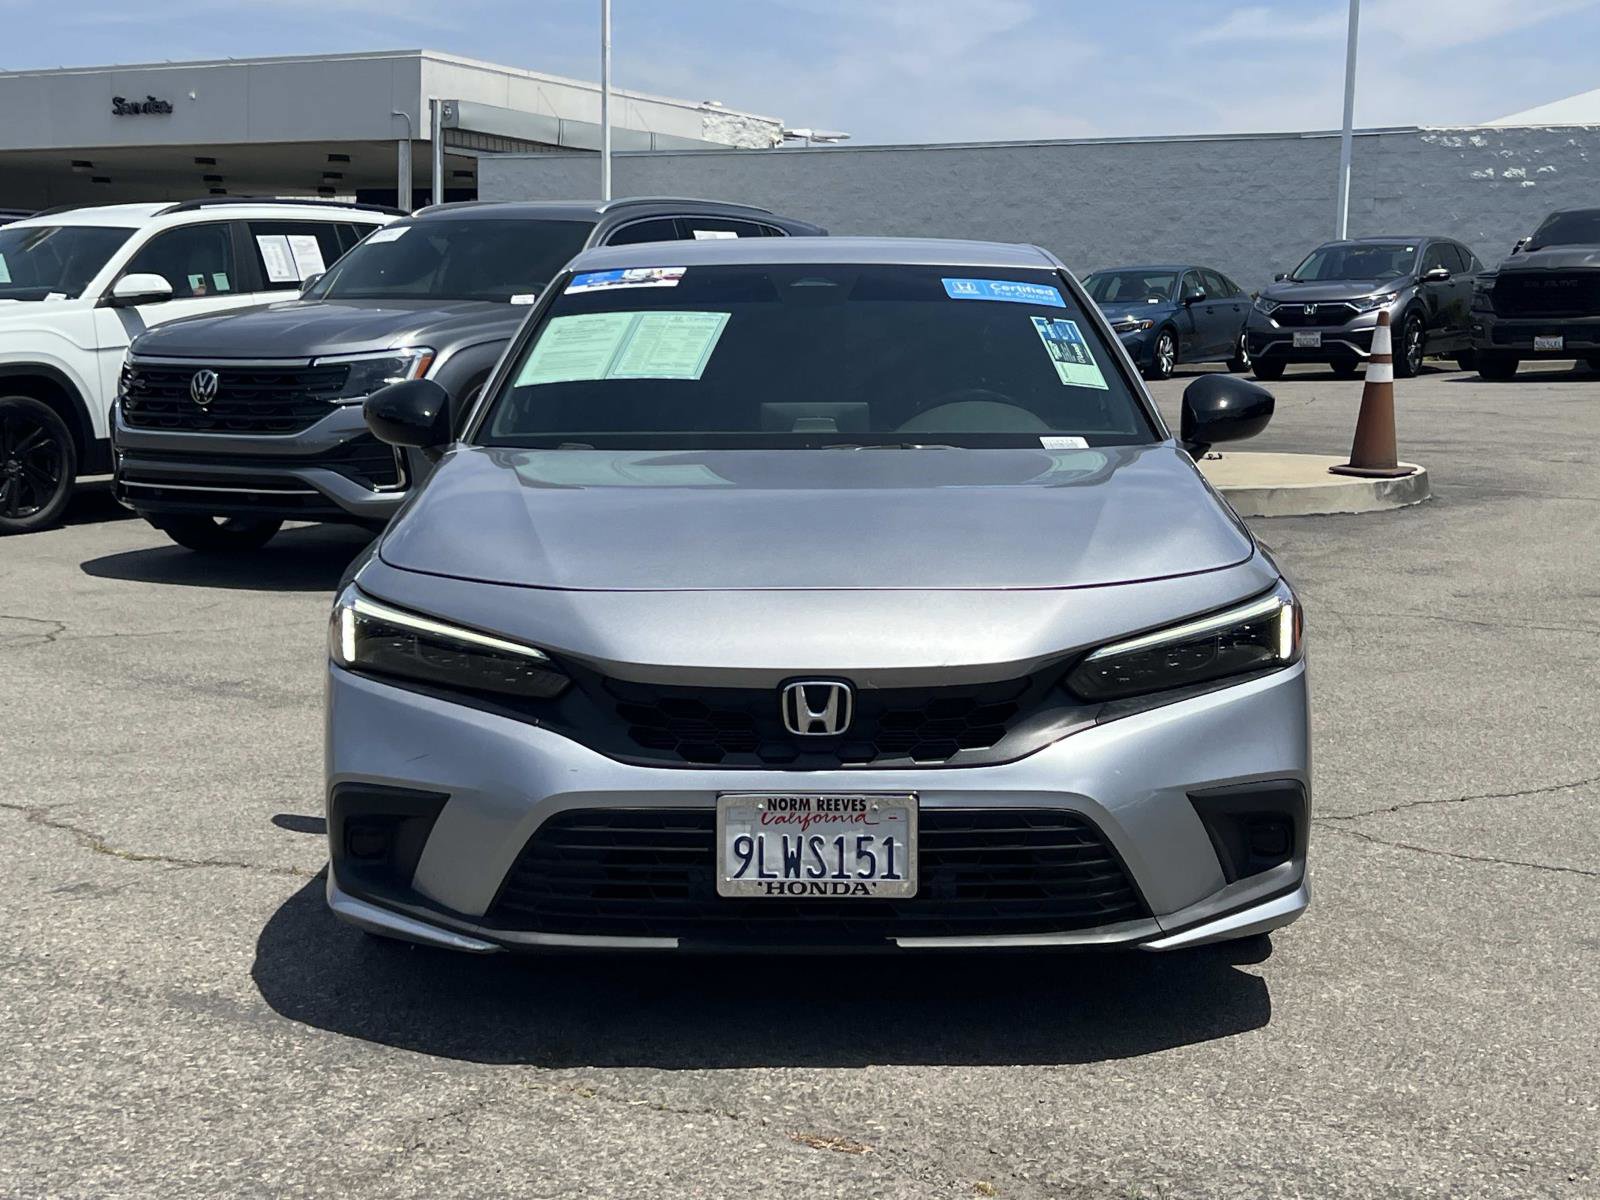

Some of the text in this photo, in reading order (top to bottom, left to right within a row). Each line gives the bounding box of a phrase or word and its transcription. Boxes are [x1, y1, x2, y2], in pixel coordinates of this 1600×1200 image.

[990, 282, 1054, 296] Certified
[767, 798, 867, 812] NORM REEVES
[761, 811, 880, 832] California
[733, 835, 901, 880] 9LWS151
[764, 881, 872, 896] HONDA
